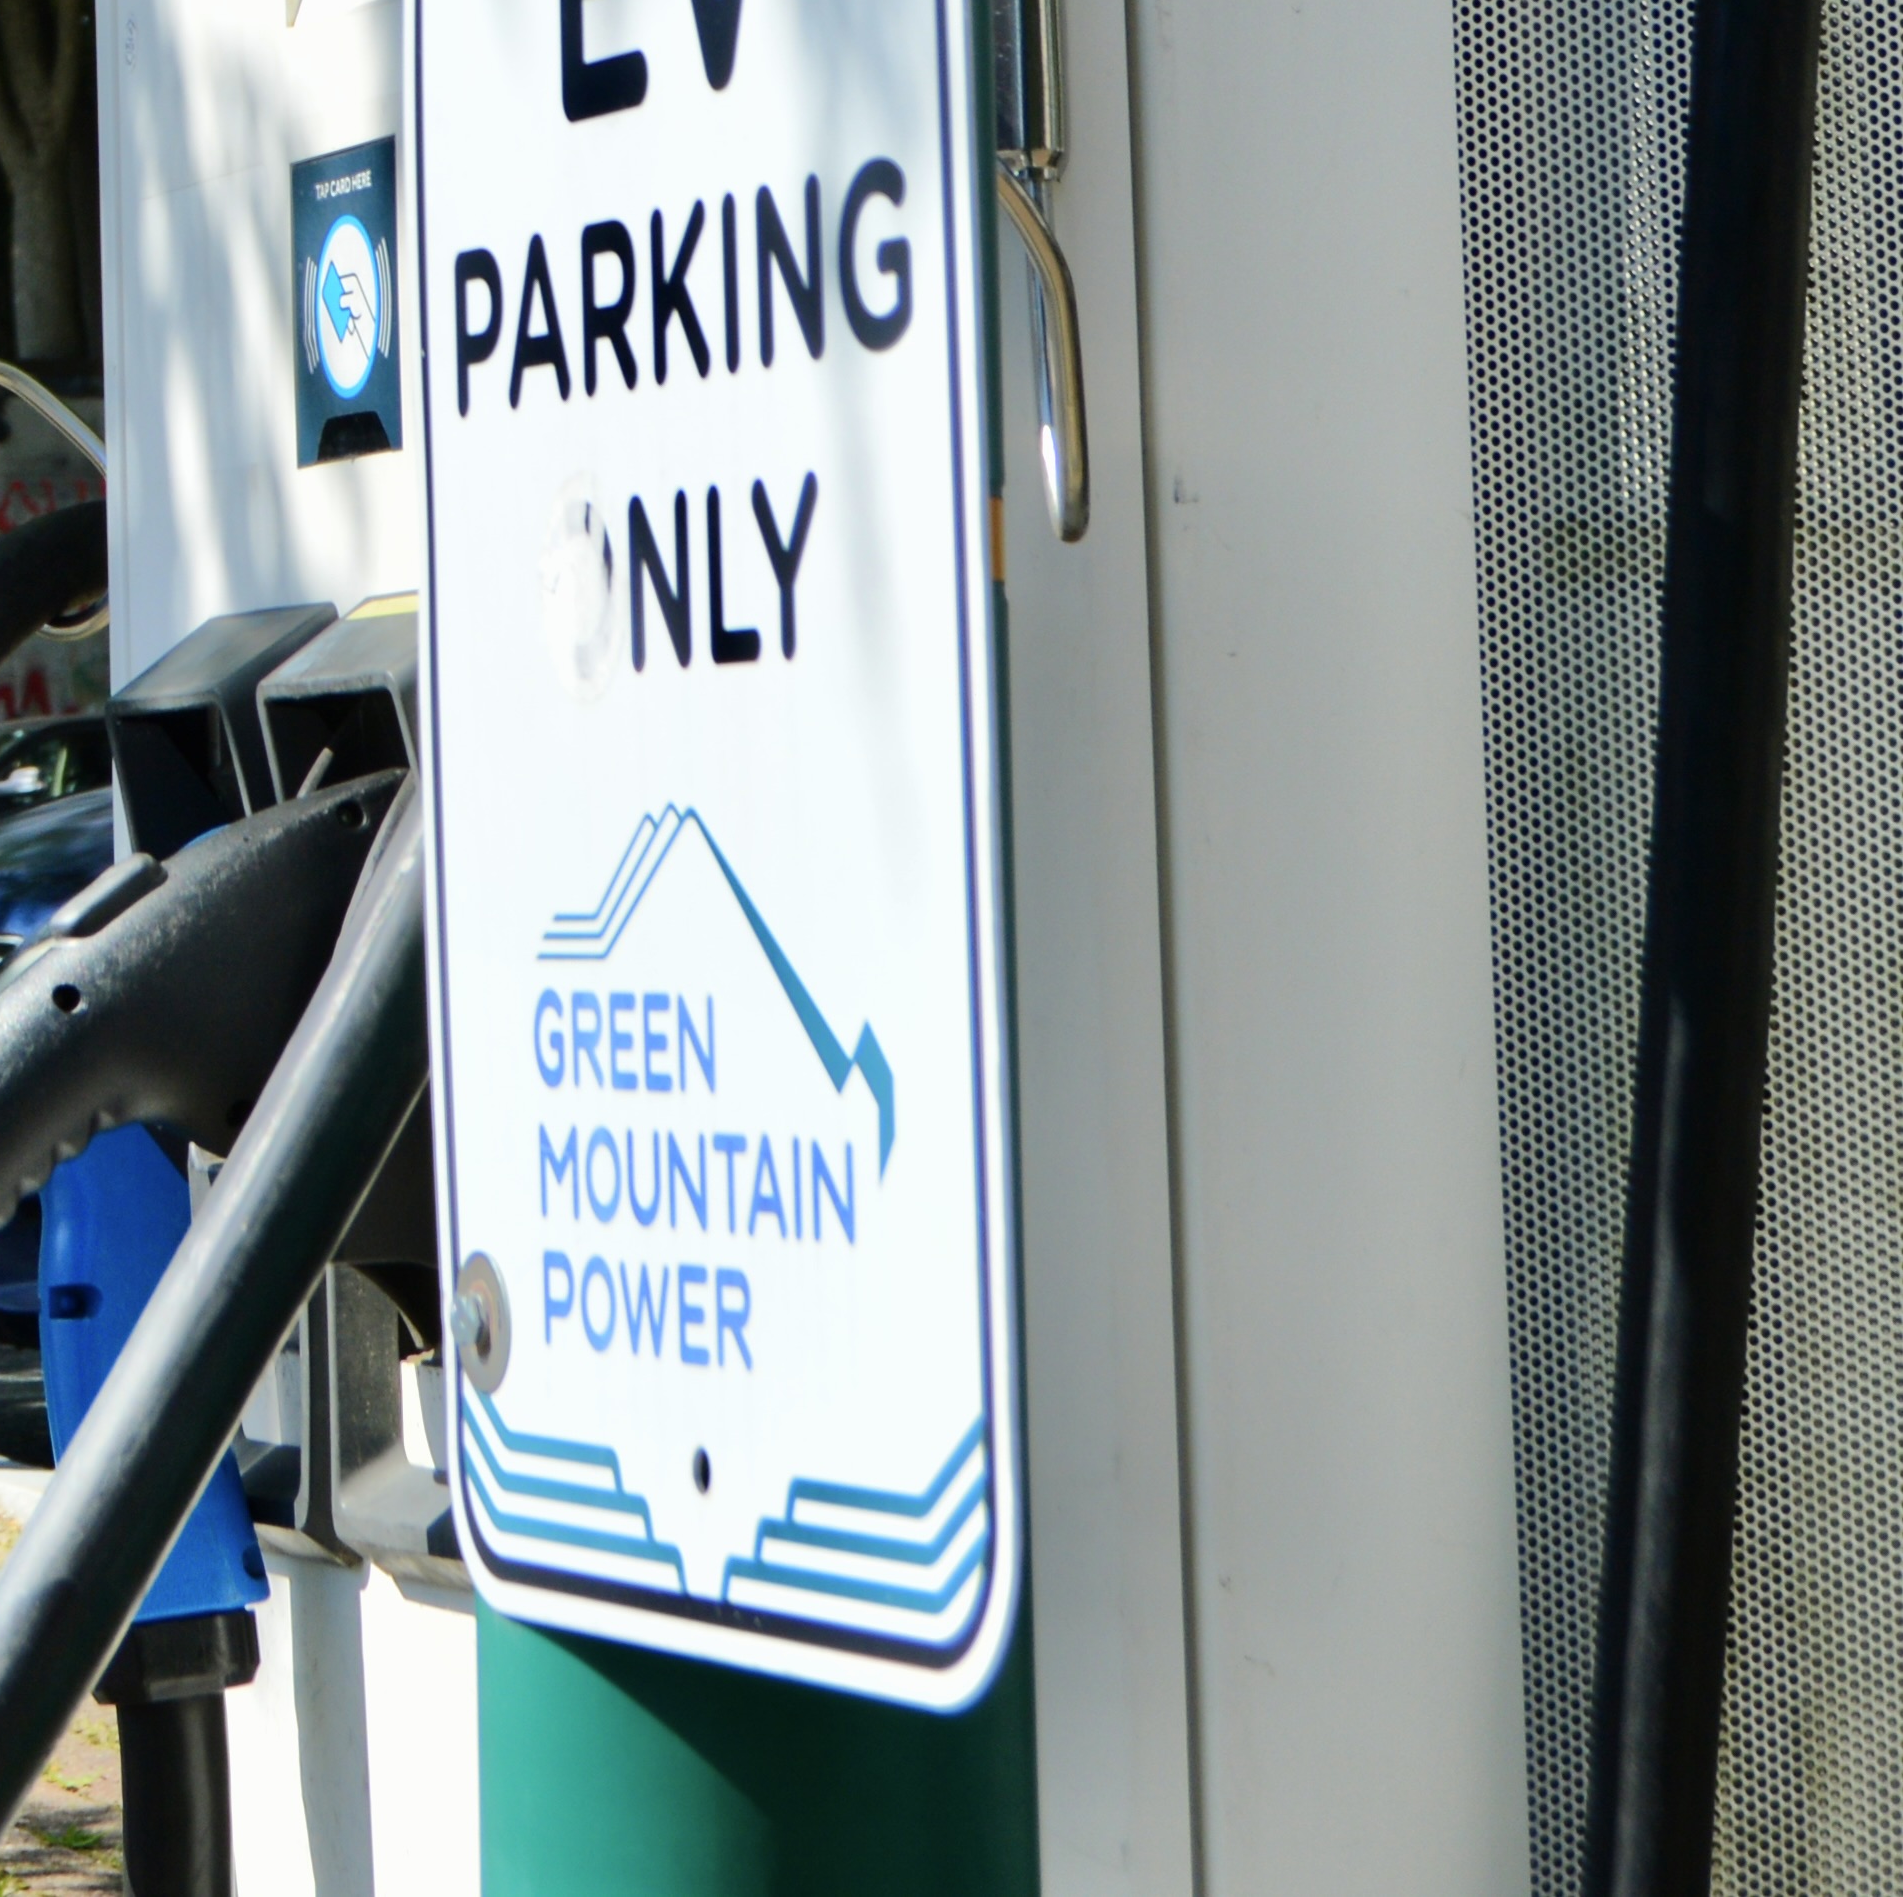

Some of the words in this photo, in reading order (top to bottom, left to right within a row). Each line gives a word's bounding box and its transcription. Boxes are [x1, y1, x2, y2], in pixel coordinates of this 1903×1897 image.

[330, 176, 351, 198] CARD
[351, 168, 372, 192] HERE
[454, 156, 915, 419] PARKING
[573, 469, 818, 674] NLY
[533, 988, 718, 1095] GREEN
[537, 1122, 857, 1245] MOUNTAIN
[542, 1249, 754, 1371] POWER
